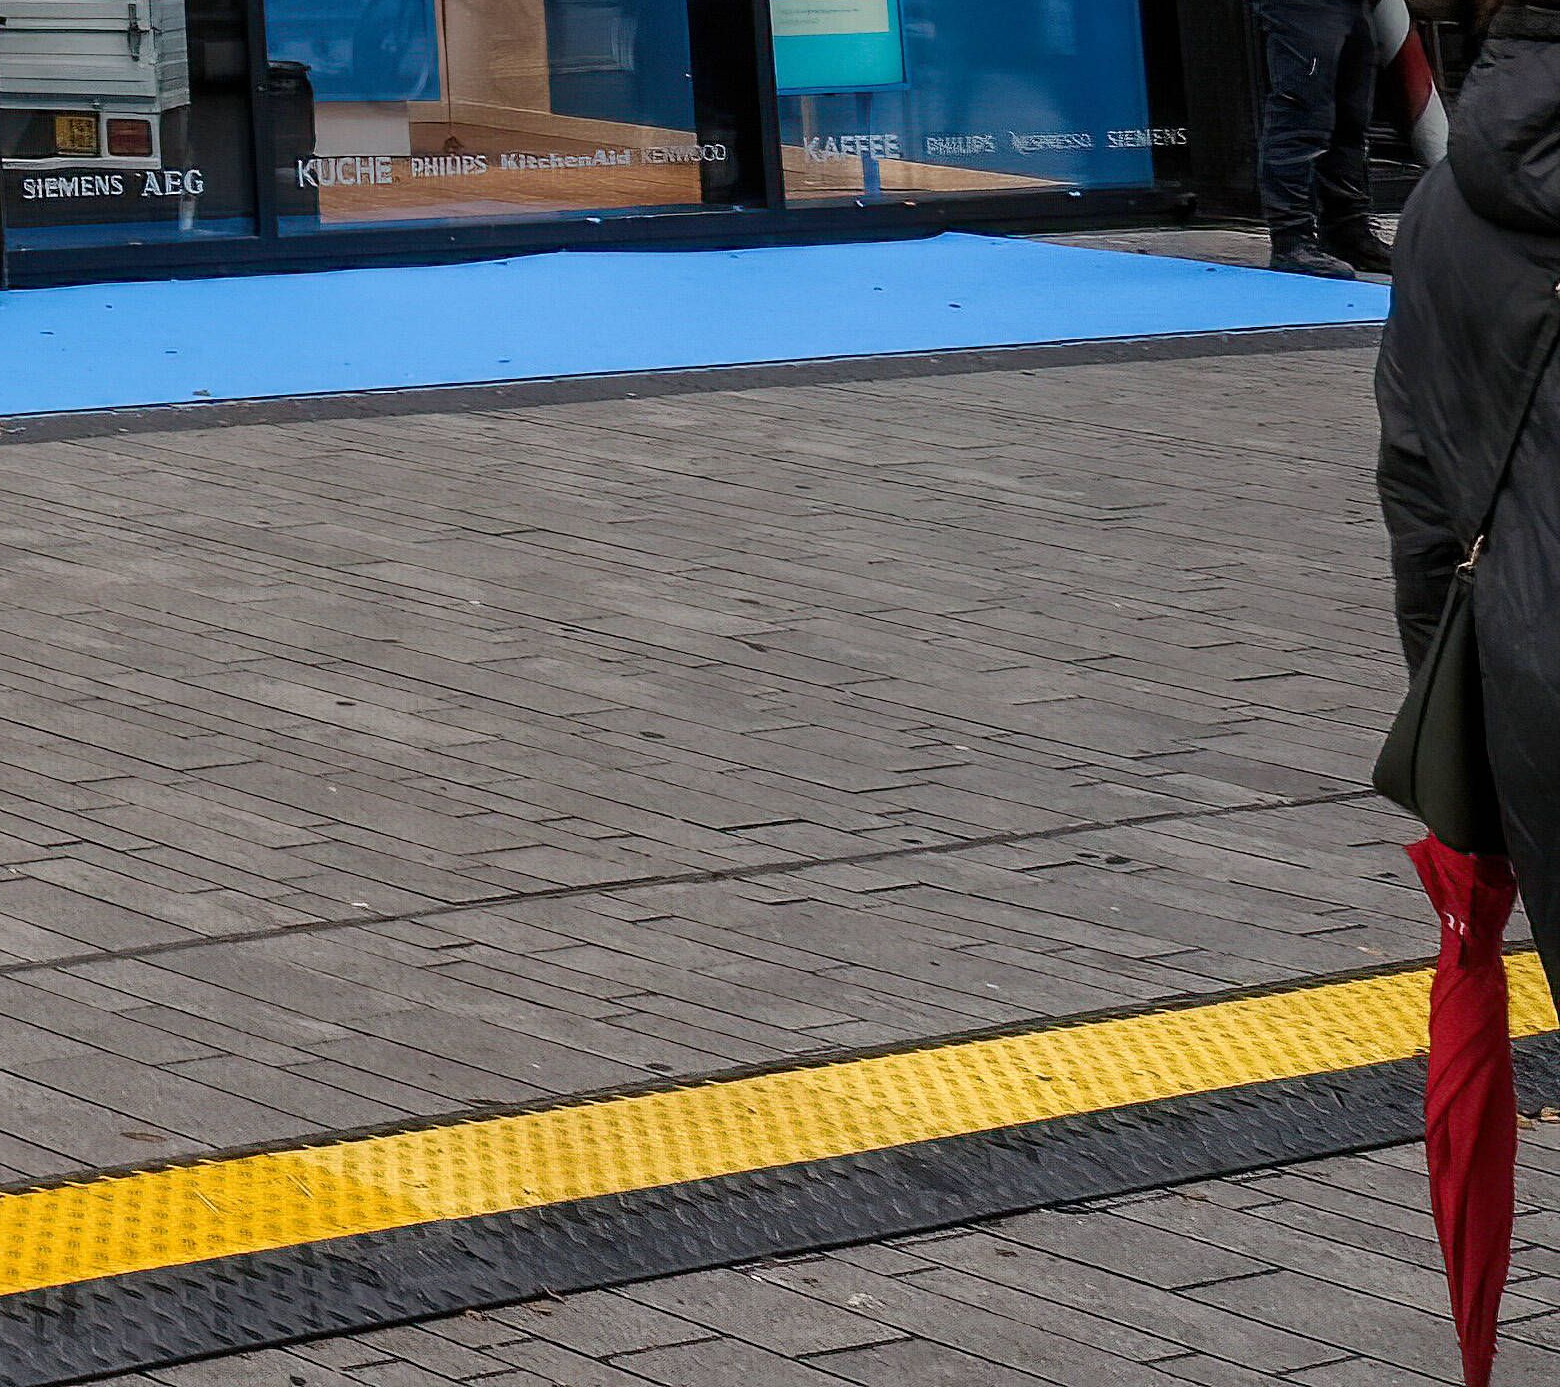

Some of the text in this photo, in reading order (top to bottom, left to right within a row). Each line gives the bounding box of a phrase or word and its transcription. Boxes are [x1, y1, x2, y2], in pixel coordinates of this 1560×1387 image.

[411, 153, 489, 179] PHILIPS
[500, 148, 632, 170] KitchenAid
[22, 170, 206, 199] SIEMENS AEG
